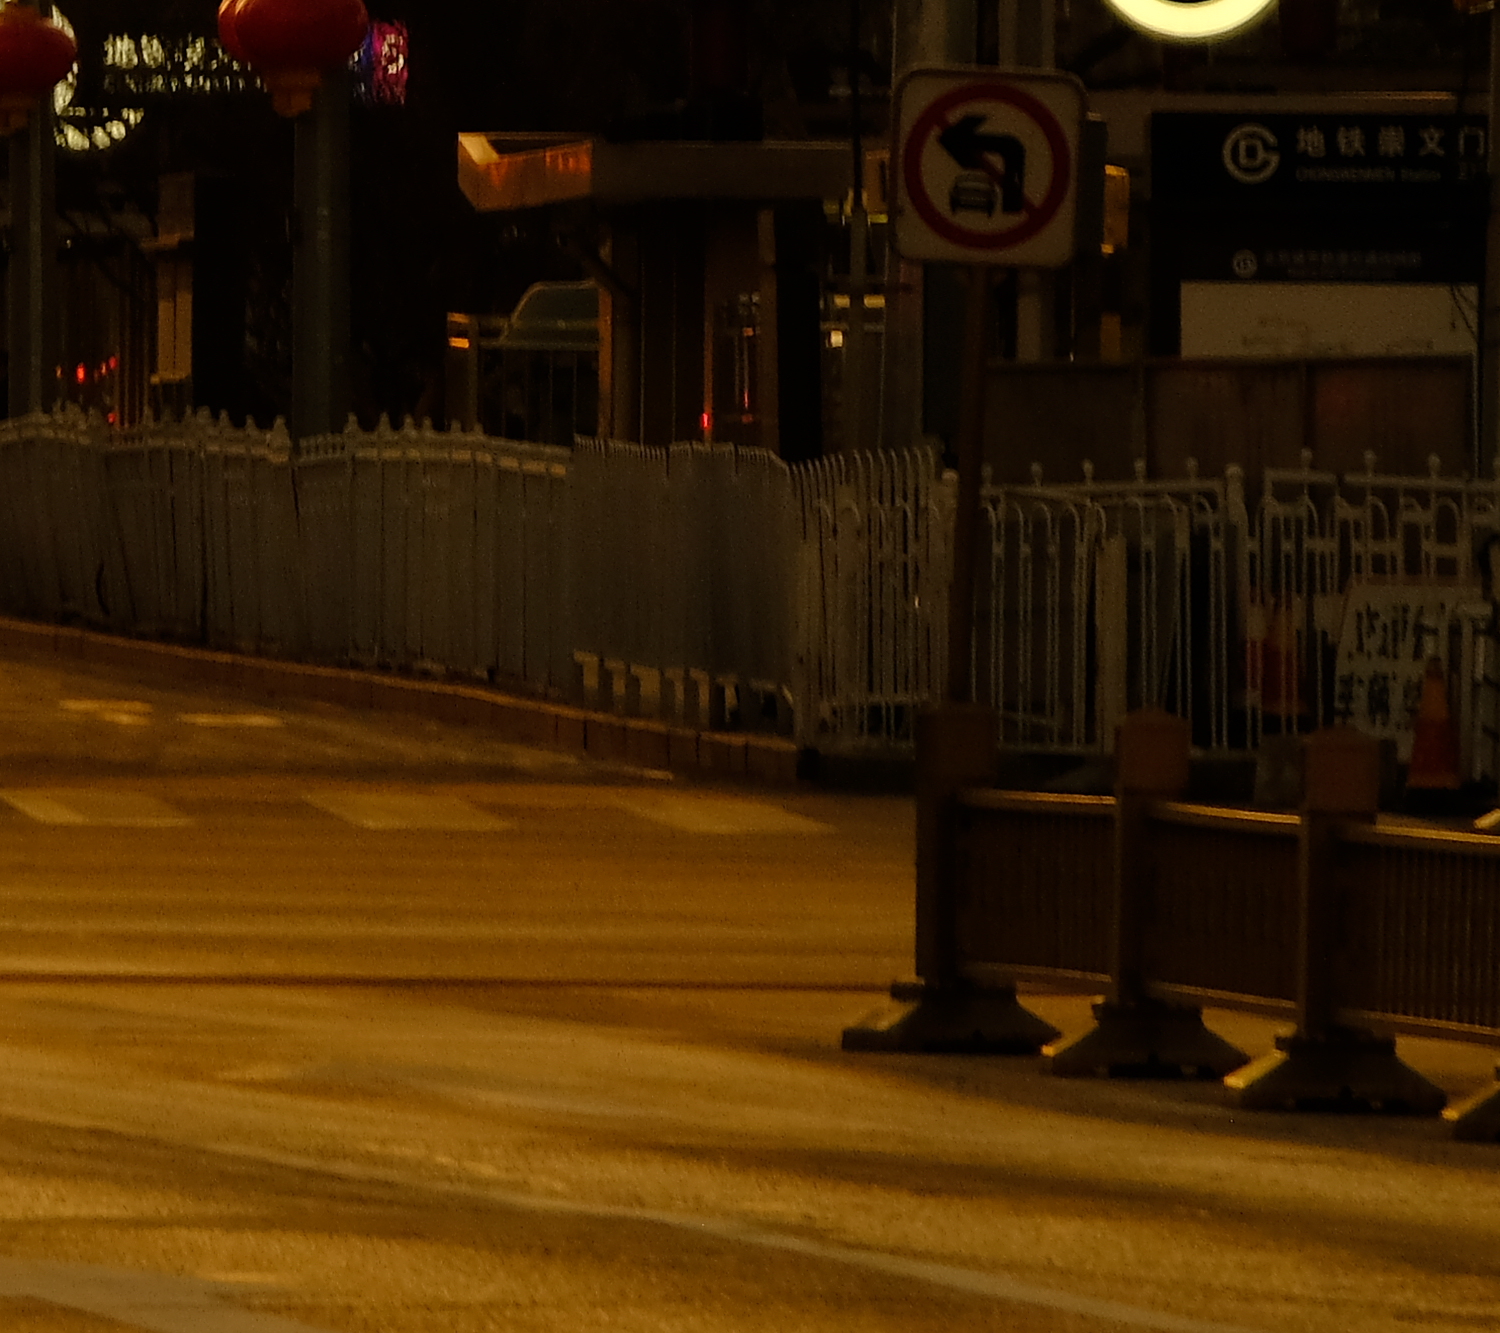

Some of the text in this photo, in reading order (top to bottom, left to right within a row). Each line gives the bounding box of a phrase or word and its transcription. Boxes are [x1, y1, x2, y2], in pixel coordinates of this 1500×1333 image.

[1296, 124, 1487, 158] 地铁崇文门
